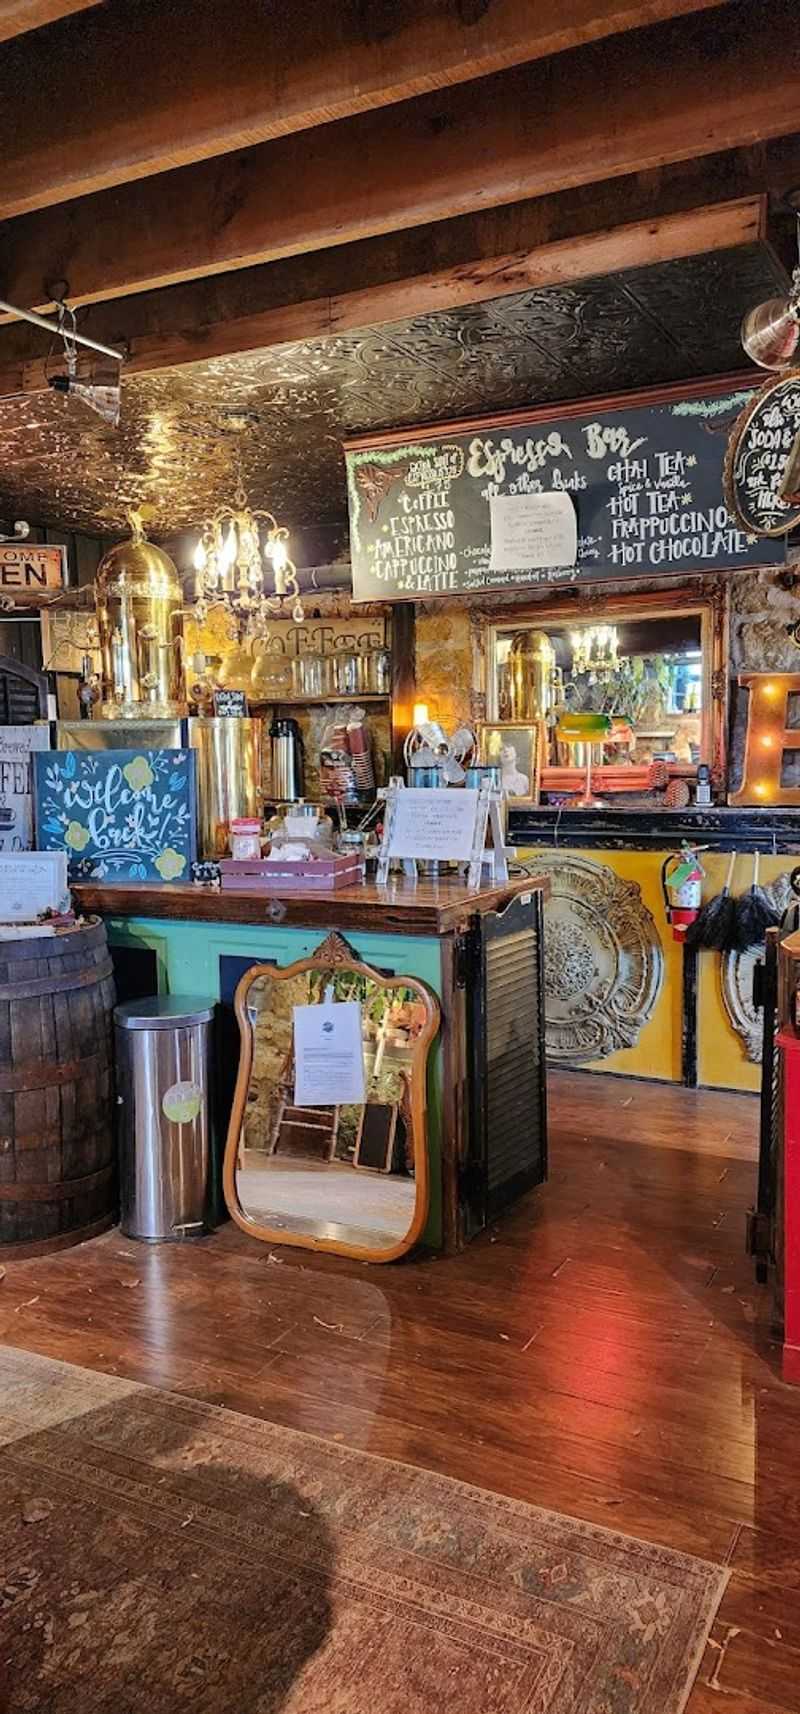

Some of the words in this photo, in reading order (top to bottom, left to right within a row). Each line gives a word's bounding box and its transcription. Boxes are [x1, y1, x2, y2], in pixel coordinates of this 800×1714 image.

[467, 432, 573, 483] Espresso
[581, 422, 649, 459] Bar
[748, 429, 782, 449] SODA
[607, 458, 648, 483] CHAI
[655, 451, 687, 478] TEA
[605, 492, 640, 518] HOT
[646, 490, 680, 515] TEA
[390, 509, 456, 537] ESPRESSO
[611, 505, 728, 541] FRAPPUCCINO
[373, 531, 456, 559] AMERICANO
[607, 541, 645, 567] HOT
[649, 528, 749, 565] CHOCOLATE
[375, 553, 457, 581] CAPPUCCINO
[63, 764, 178, 814] welcome
